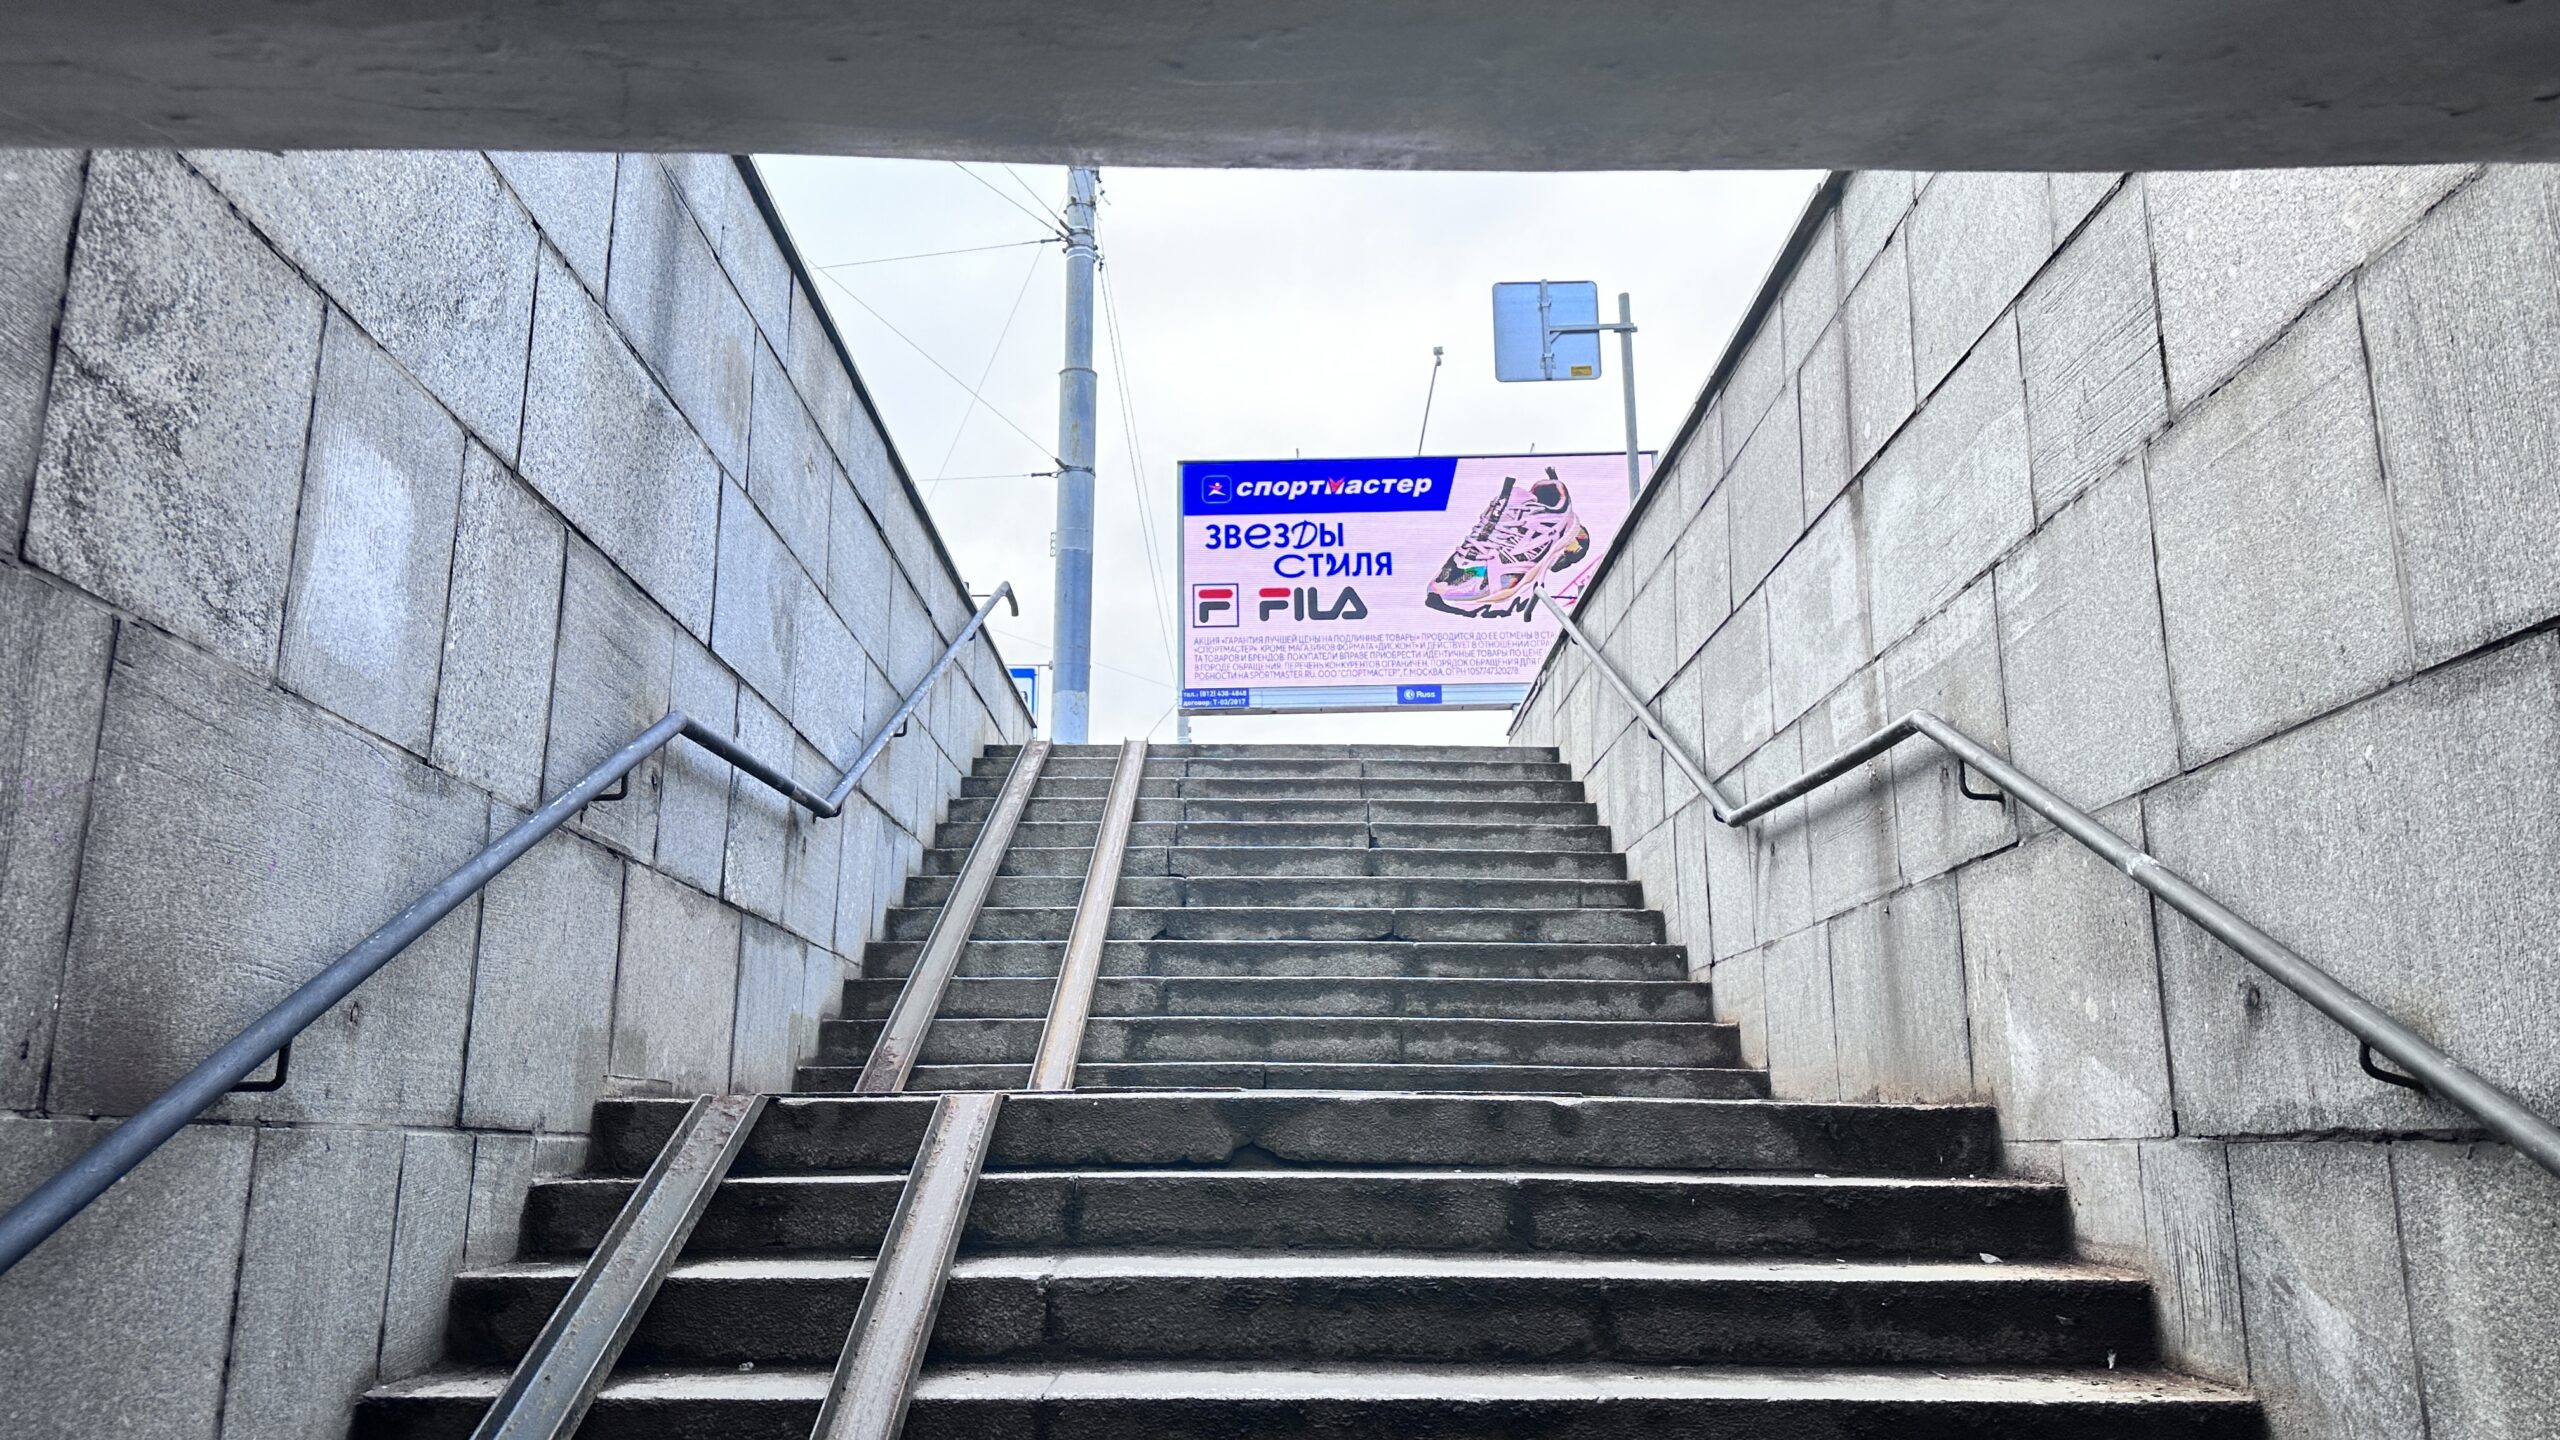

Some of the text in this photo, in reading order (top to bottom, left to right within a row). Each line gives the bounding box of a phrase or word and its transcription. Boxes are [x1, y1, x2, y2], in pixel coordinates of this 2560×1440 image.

[1236, 477, 1432, 500] спортмастер
[1259, 586, 1368, 621] FILA
[1194, 637, 1220, 645] АКЦИЯ
[1222, 636, 1263, 644] «ГАРАНТИЯ
[1265, 634, 1297, 643] ЛУЧШЕЙ
[1299, 635, 1320, 643] ЦЕНЫ
[1334, 634, 1383, 642] ПОДЛИННЫЕ
[1422, 633, 1474, 641] ПРОВОДИТСЯ
[1476, 632, 1487, 640] ДО
[1337, 643, 1373, 651] ФОРМАТА
[1427, 641, 1469, 649] ДЕЙСТВУЕТ
[1478, 640, 1529, 648] ОТНОШЕНИИ
[1204, 654, 1240, 662] ТОВАРОВ
[1287, 652, 1337, 660] ПОКУПАТЕЛИ
[1340, 652, 1368, 660] ВПРАВЕ
[1370, 651, 1421, 659] ПРИОБРЕСТИ
[1423, 650, 1475, 658] ИДЕНТИЧНЫЕ
[1477, 649, 1507, 657] ТОВАРЫ
[1523, 648, 1543, 657] ЦЕНЕ
[1201, 663, 1230, 671] ГОРОДЕ
[1325, 661, 1380, 669] КОНКУРЕНТОВ
[1431, 659, 1467, 668] ПОРЯДОК
[1470, 658, 1518, 666] ОБРАЩЕНИЯ
[1520, 658, 1536, 667] ДЛЯ
[1194, 672, 1237, 680] РОБНОСТИ
[1446, 667, 1466, 676] ОГРН
